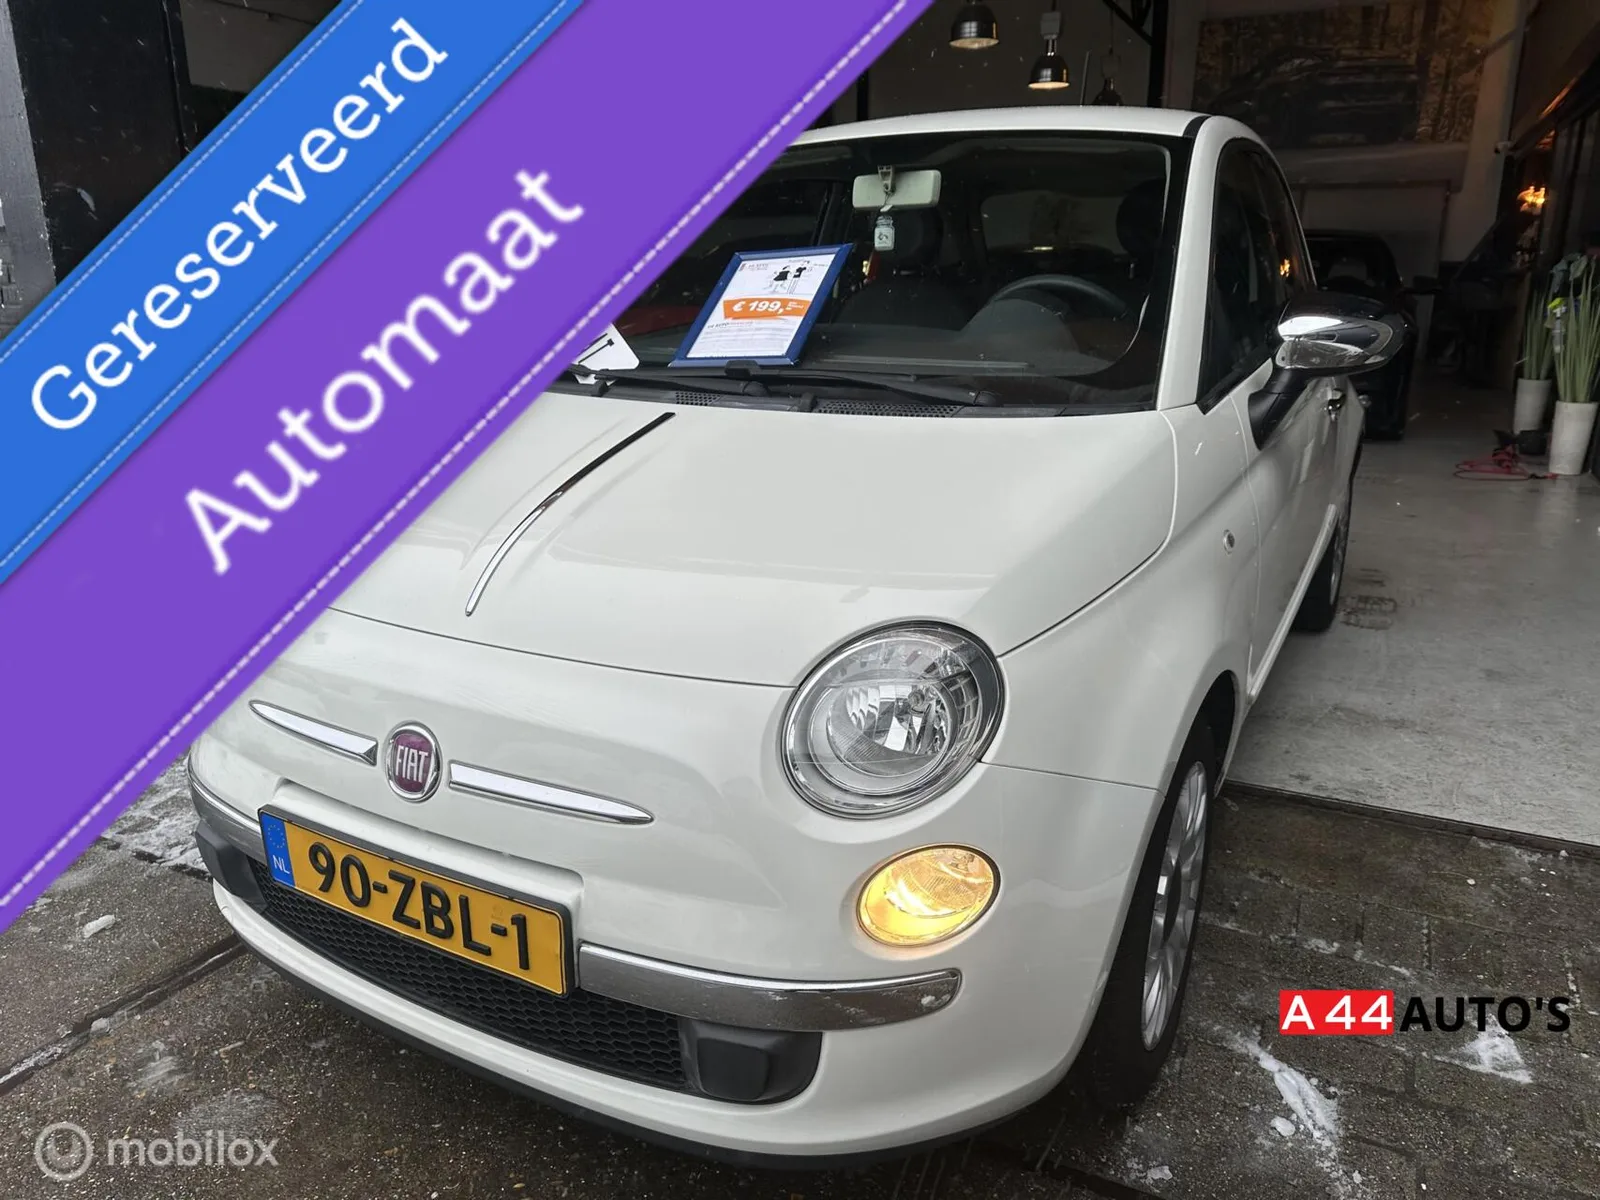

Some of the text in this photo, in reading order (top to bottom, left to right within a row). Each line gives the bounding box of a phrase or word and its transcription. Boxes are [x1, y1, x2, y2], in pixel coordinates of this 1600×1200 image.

[395, 745, 429, 783] FIAT
[272, 855, 291, 875] NL
[308, 842, 530, 970] 90-ZBL-1
